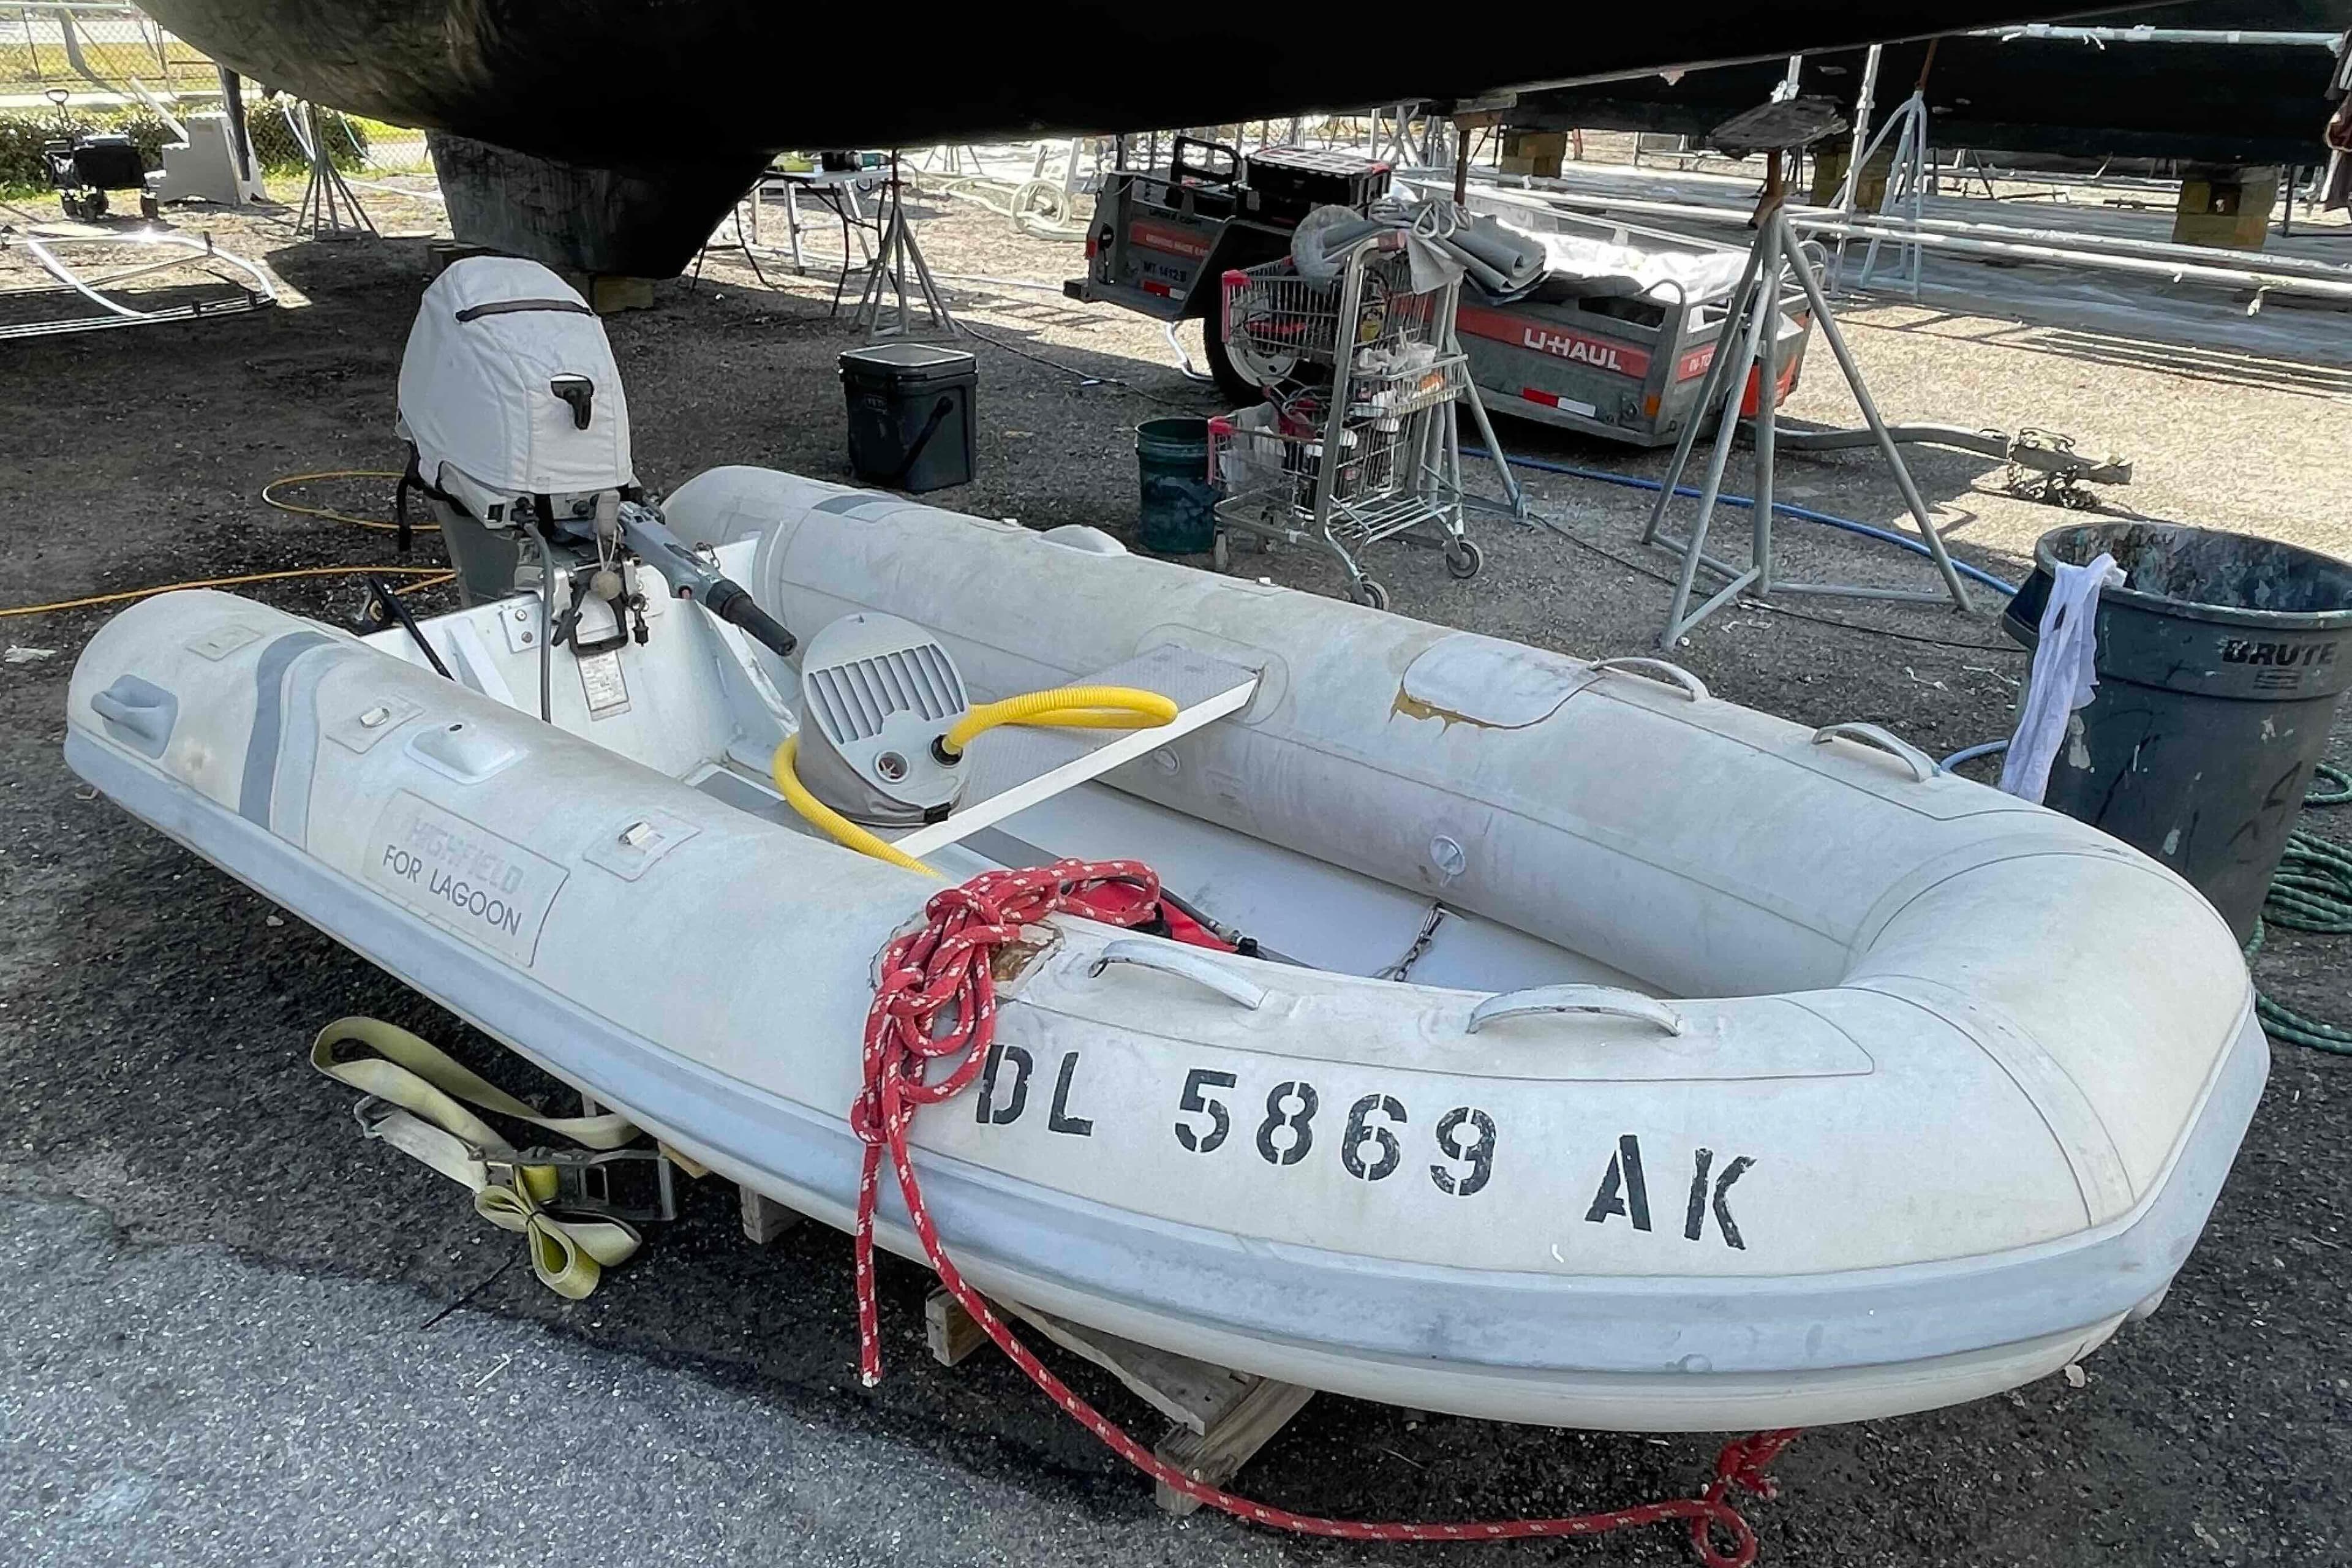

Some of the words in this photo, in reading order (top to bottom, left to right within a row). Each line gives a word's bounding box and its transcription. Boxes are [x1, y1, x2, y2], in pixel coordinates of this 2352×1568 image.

[1524, 328, 1621, 371] U-HAUL
[2222, 639, 2339, 666] BRUTE
[383, 844, 423, 883] FOR
[429, 868, 522, 936] LAGOON
[976, 1044, 1094, 1136] DL
[1175, 1069, 1496, 1196] 5869
[1585, 1134, 1757, 1250] AK
